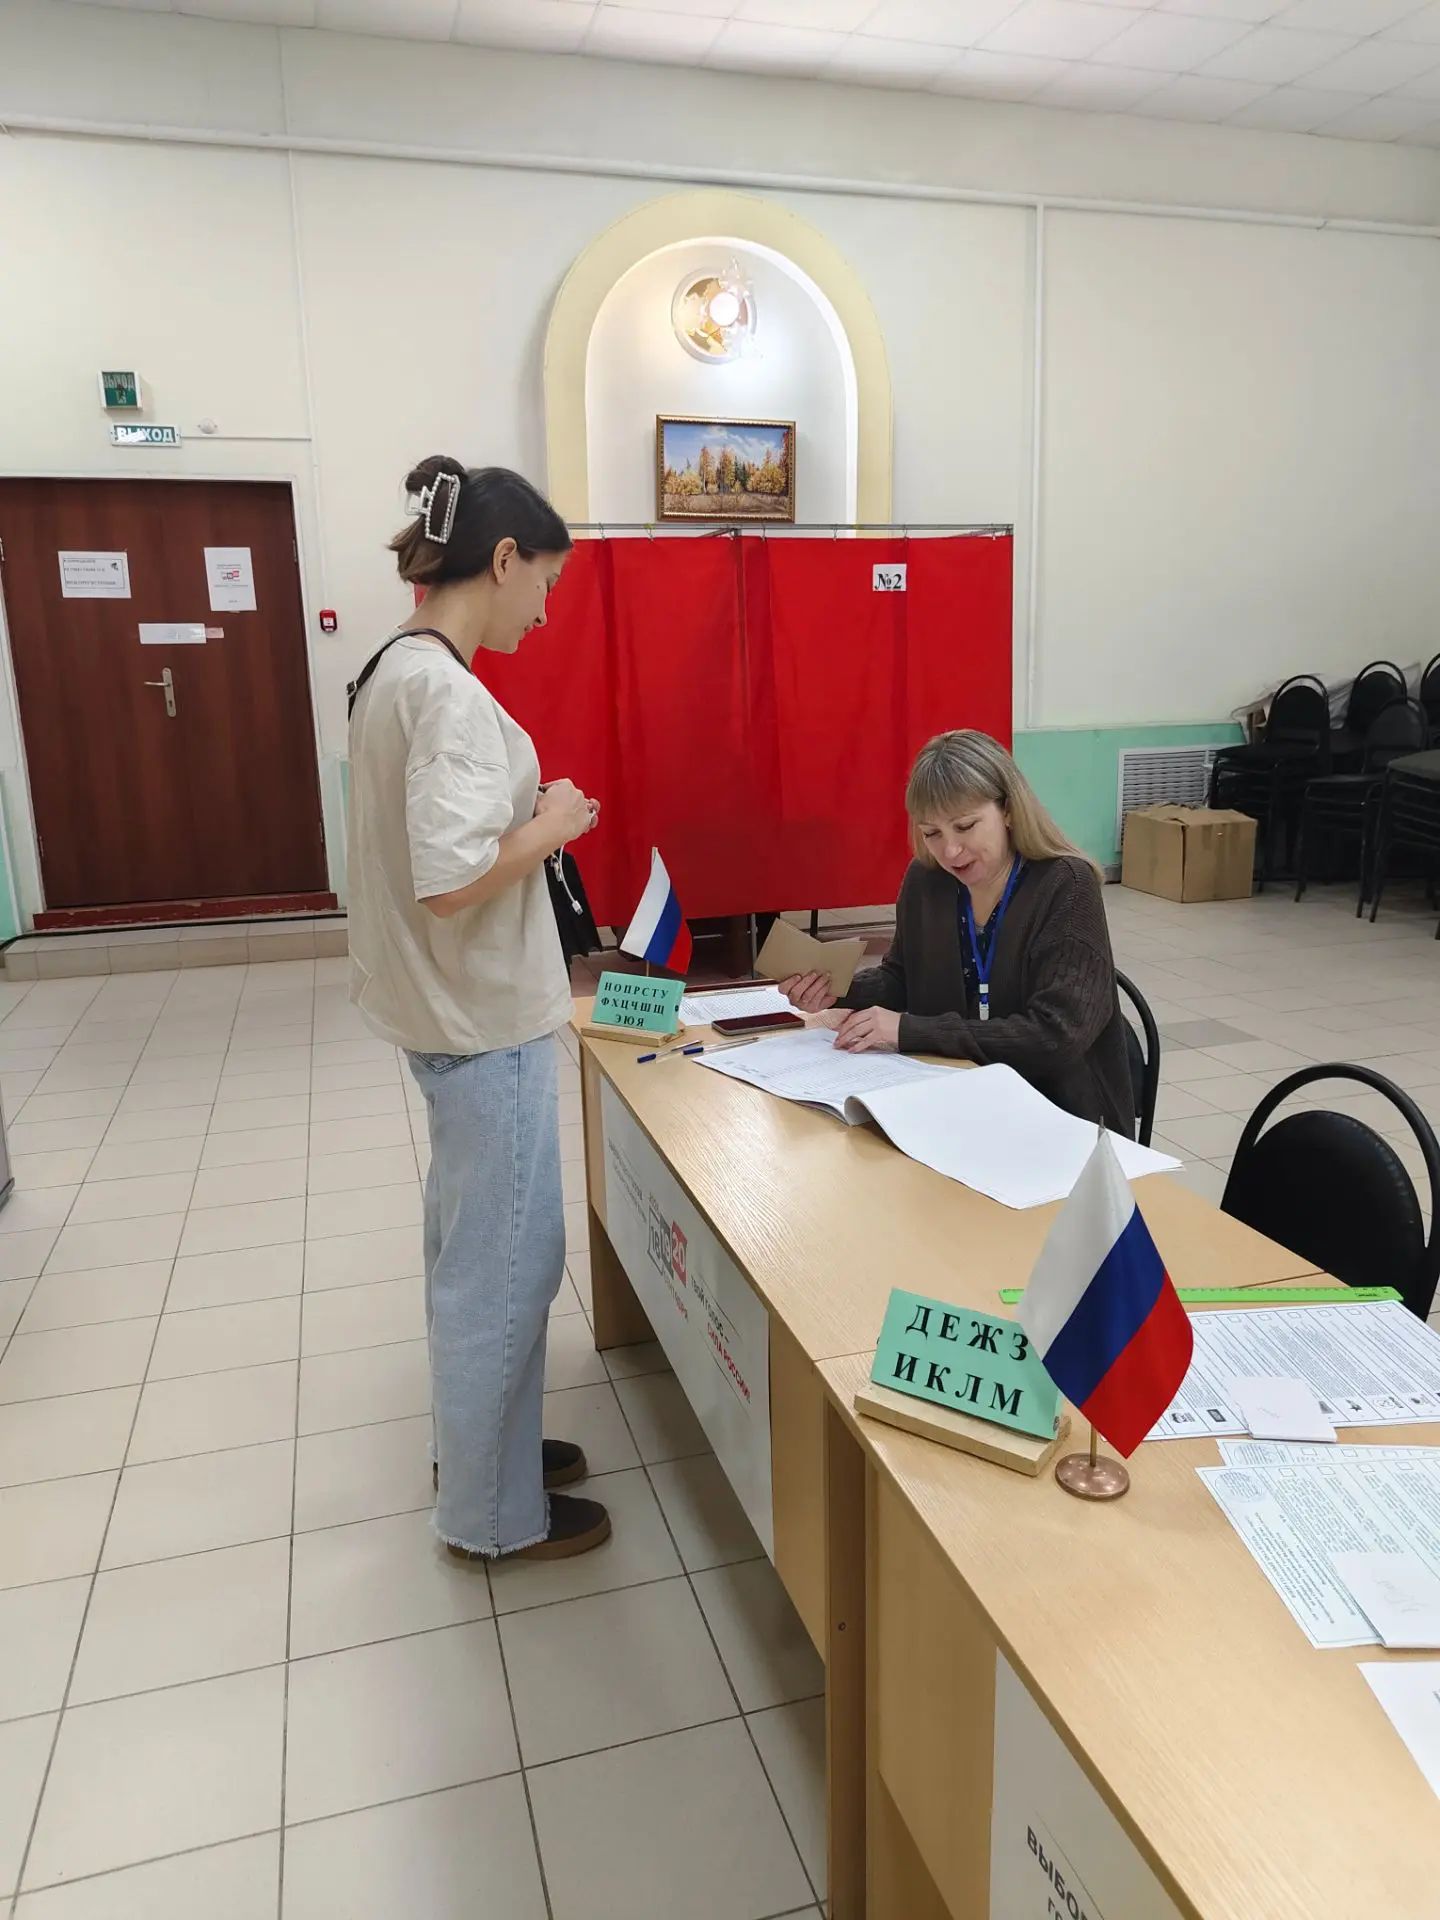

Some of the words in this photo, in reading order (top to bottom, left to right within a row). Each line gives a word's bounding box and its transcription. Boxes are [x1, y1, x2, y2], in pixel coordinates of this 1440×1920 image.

[874, 573, 902, 590] №2
[604, 982, 669, 999] НОПРСТУ
[601, 998, 664, 1015] ФХЦЧШЩ
[615, 1014, 644, 1027] ЭЮЯ
[672, 1231, 685, 1273] 20
[707, 1321, 722, 1356] СИЛА
[891, 1352, 1024, 1417] ИКЛМ
